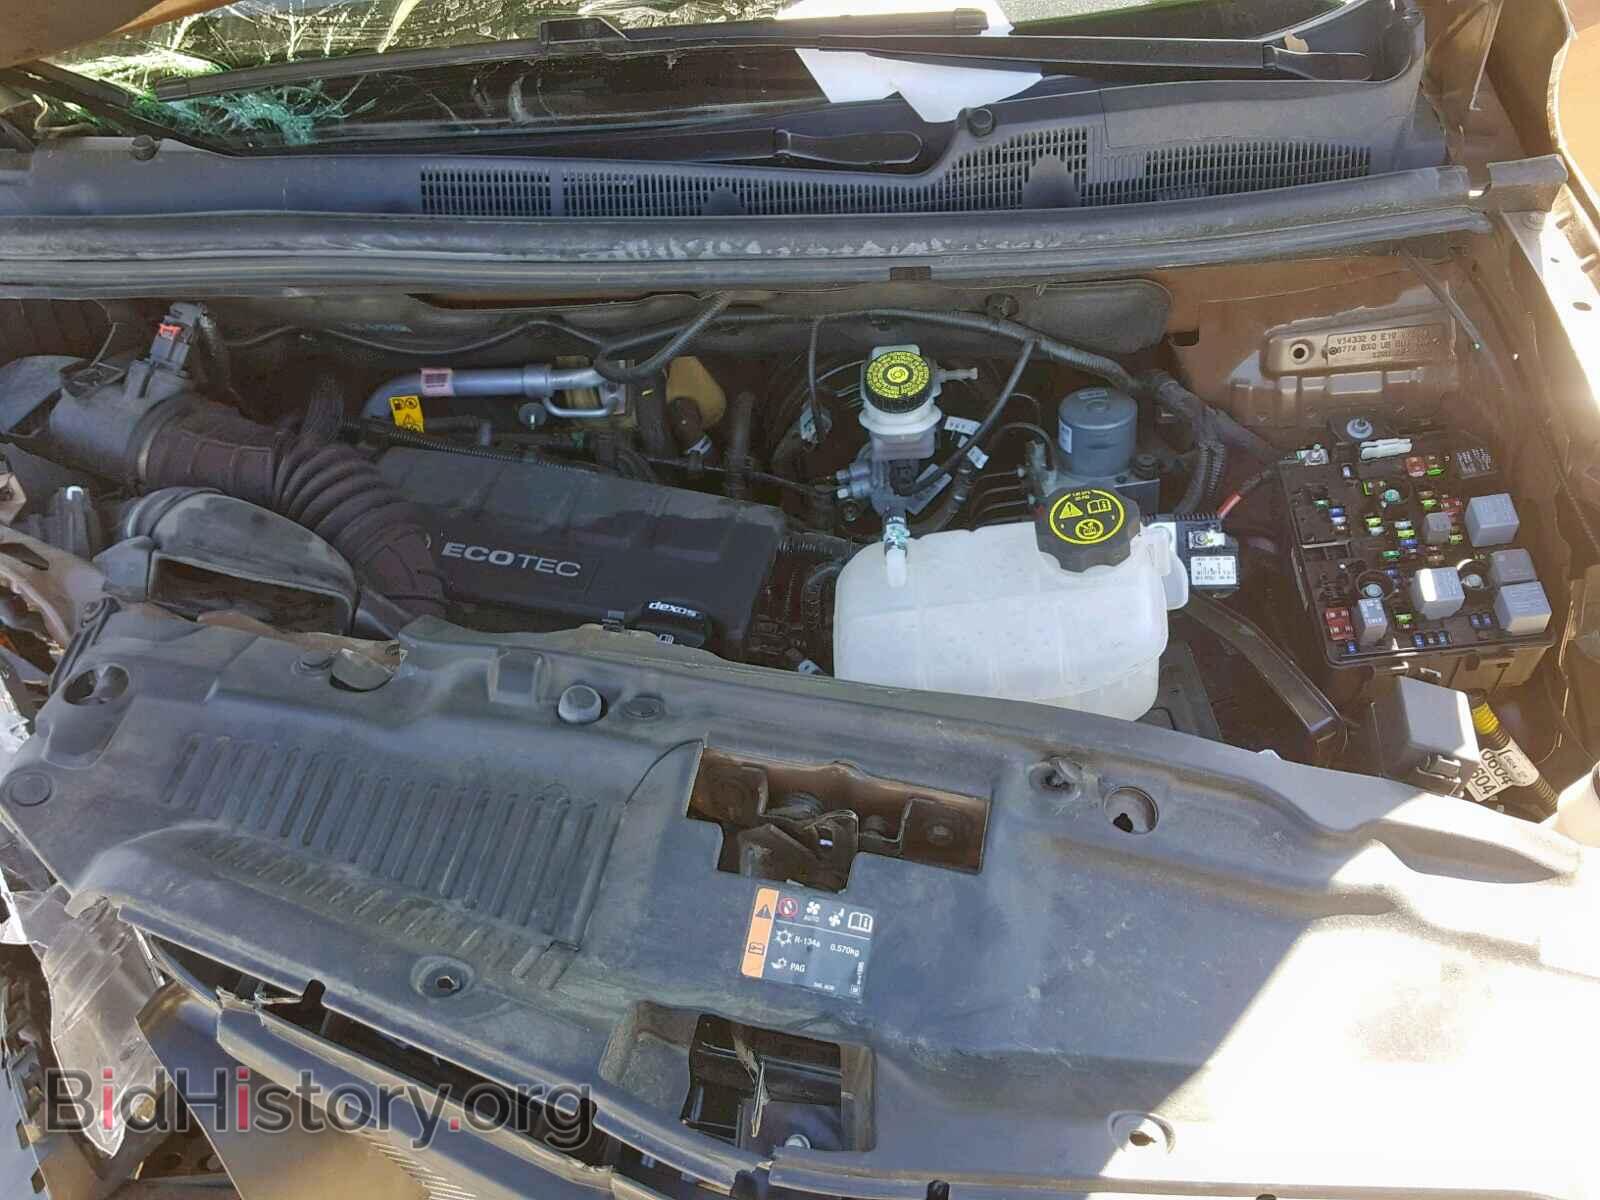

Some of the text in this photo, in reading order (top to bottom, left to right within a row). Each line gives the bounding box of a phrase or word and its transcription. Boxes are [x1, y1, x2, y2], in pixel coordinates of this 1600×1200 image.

[441, 541, 582, 577] ECOTEC
[648, 601, 697, 617] dexos
[803, 914, 820, 923] AUTO
[789, 961, 806, 973] PAG
